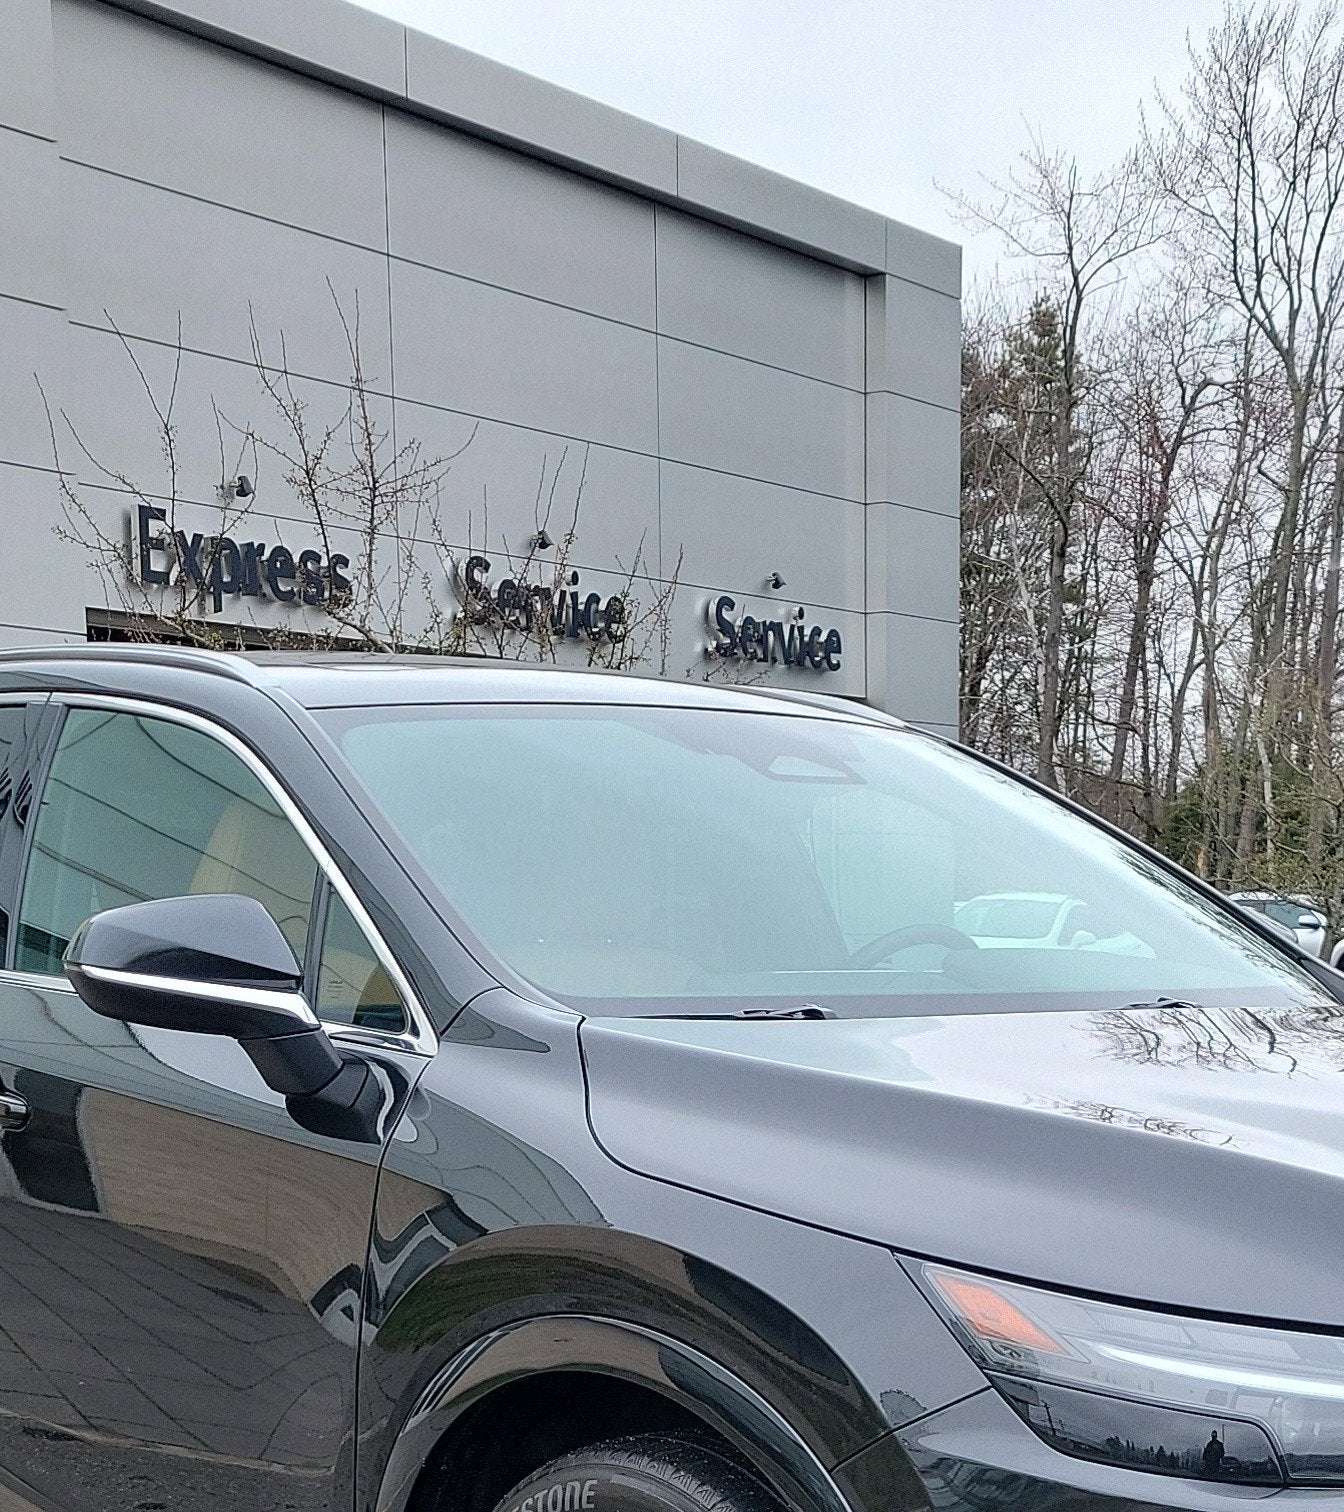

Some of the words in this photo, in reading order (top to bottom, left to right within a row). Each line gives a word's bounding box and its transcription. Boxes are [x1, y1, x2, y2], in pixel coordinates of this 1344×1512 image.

[134, 503, 353, 614] Express
[463, 555, 627, 645] Service
[712, 595, 843, 673] Service
